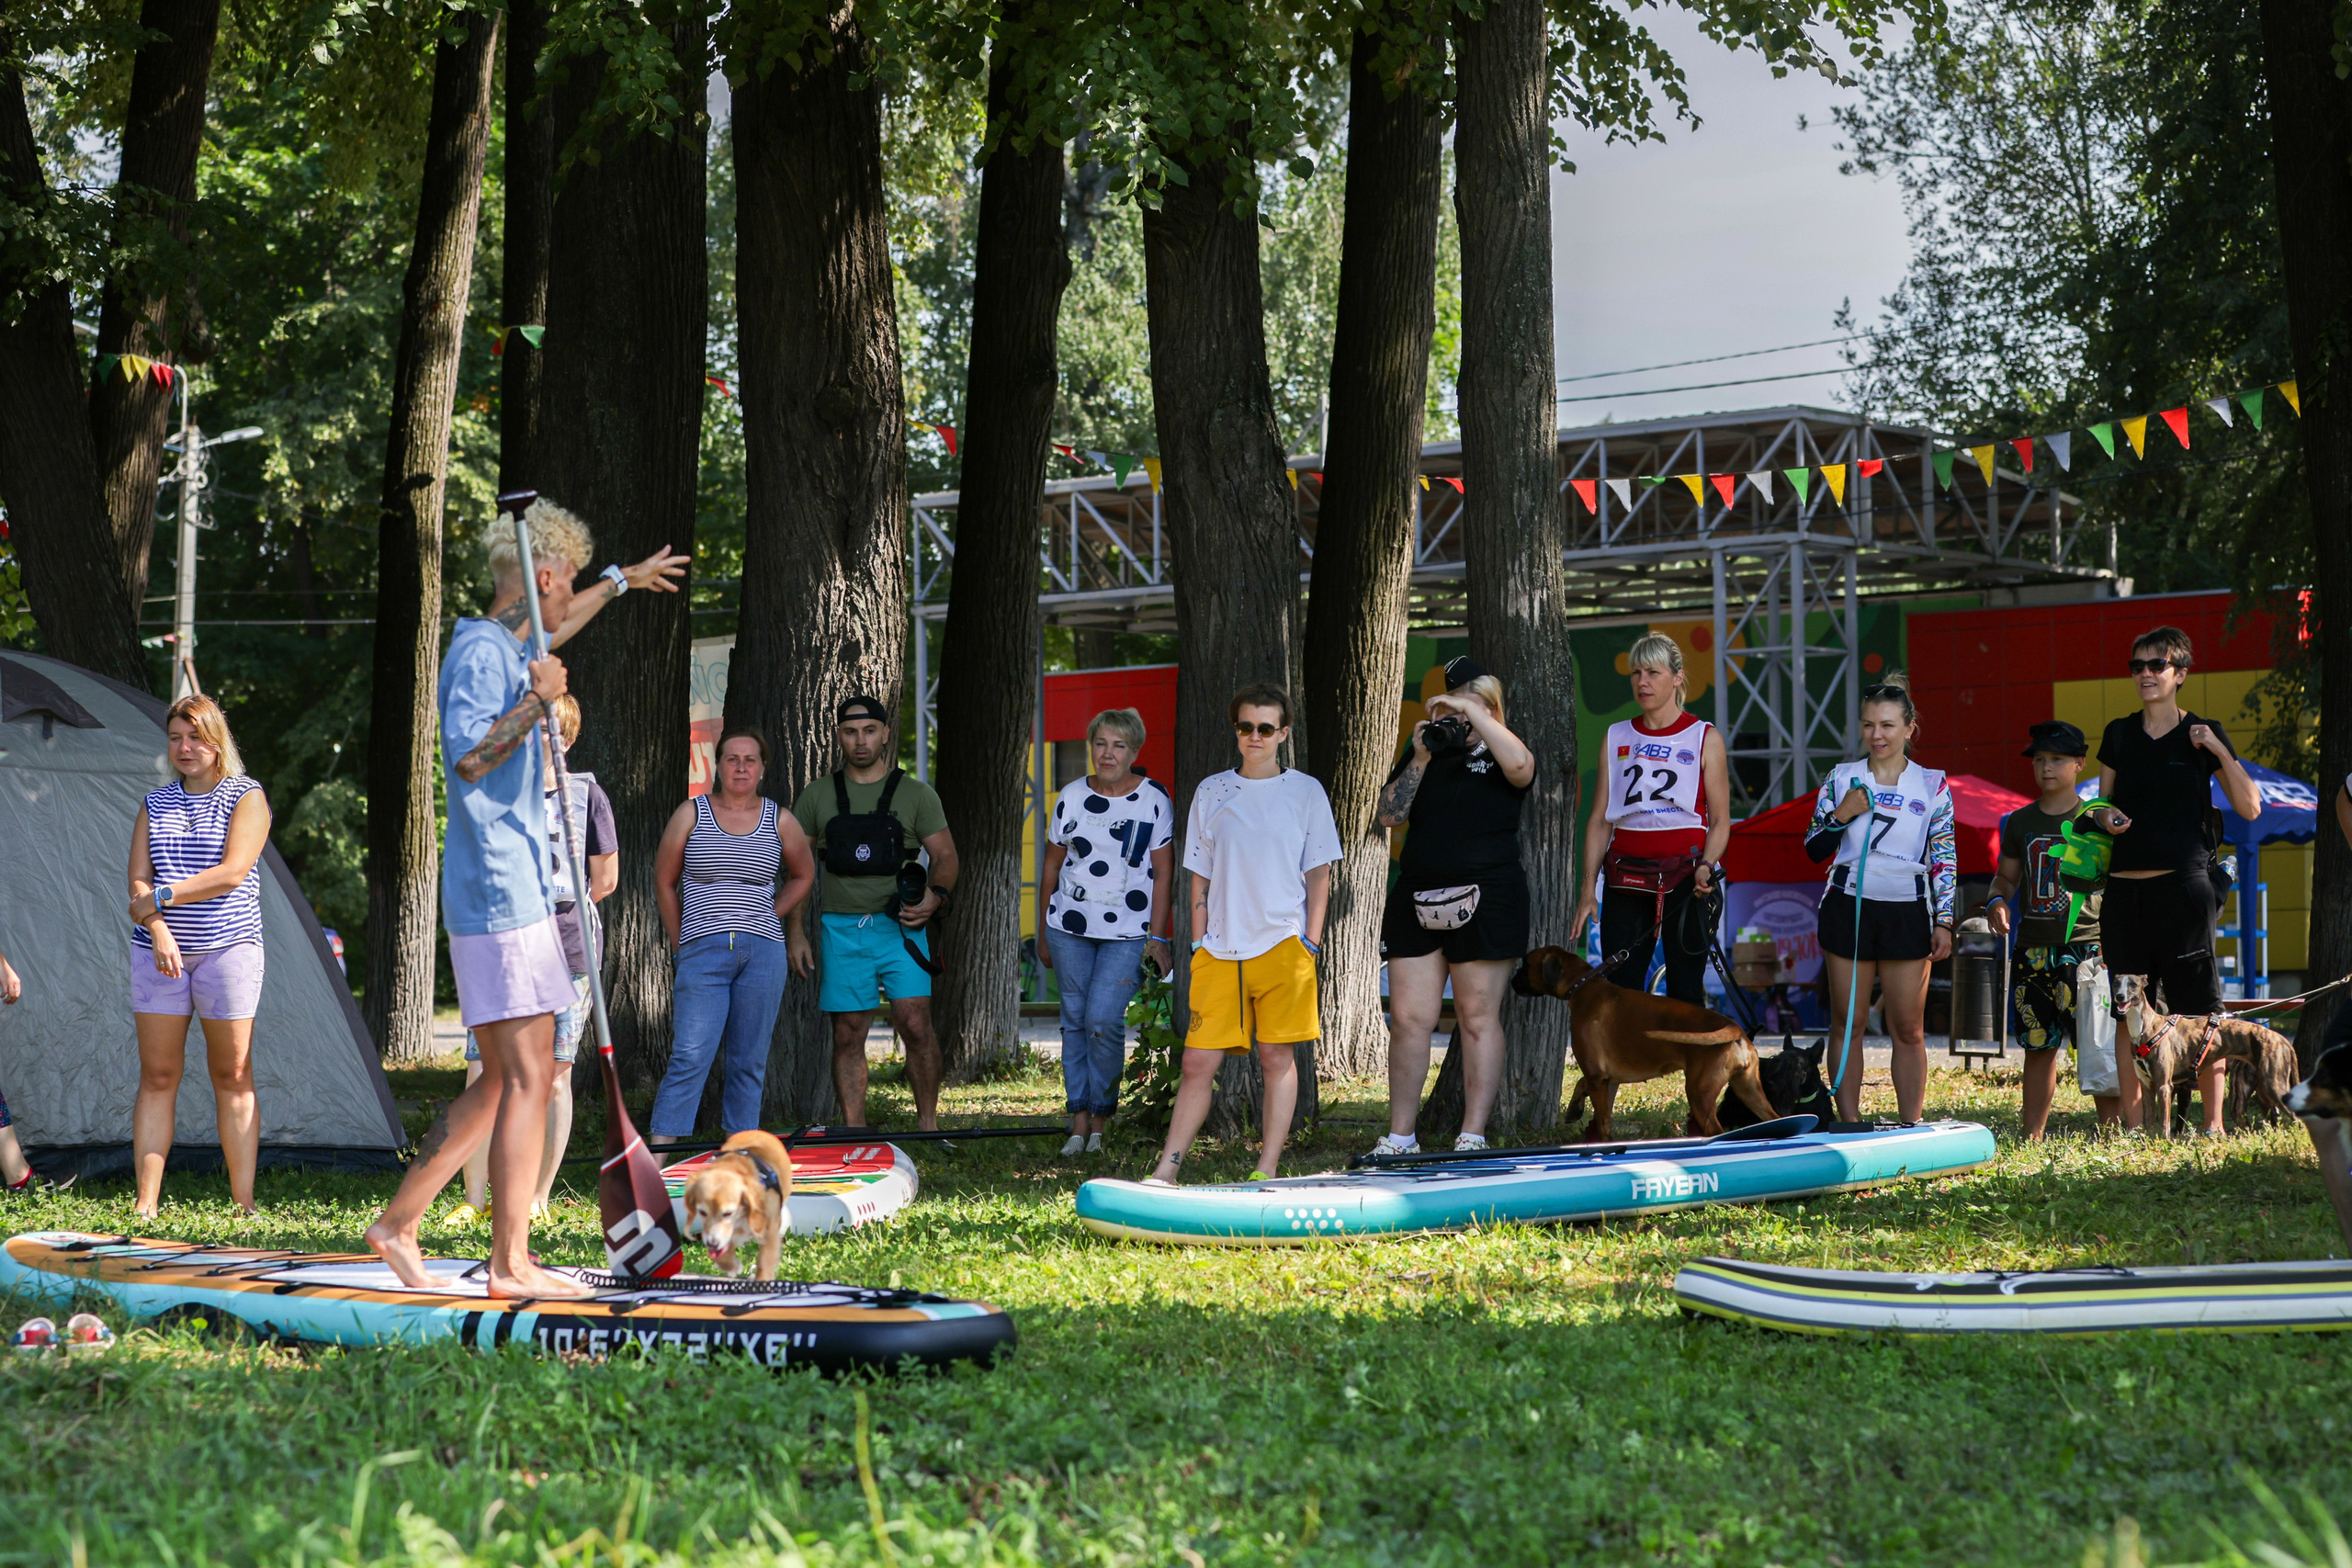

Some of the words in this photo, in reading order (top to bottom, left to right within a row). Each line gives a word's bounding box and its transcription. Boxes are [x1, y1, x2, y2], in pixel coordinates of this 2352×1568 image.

[1623, 764, 1678, 807] 22
[1871, 812, 1897, 850] 7
[1631, 1172, 1718, 1200] FAYEAN
